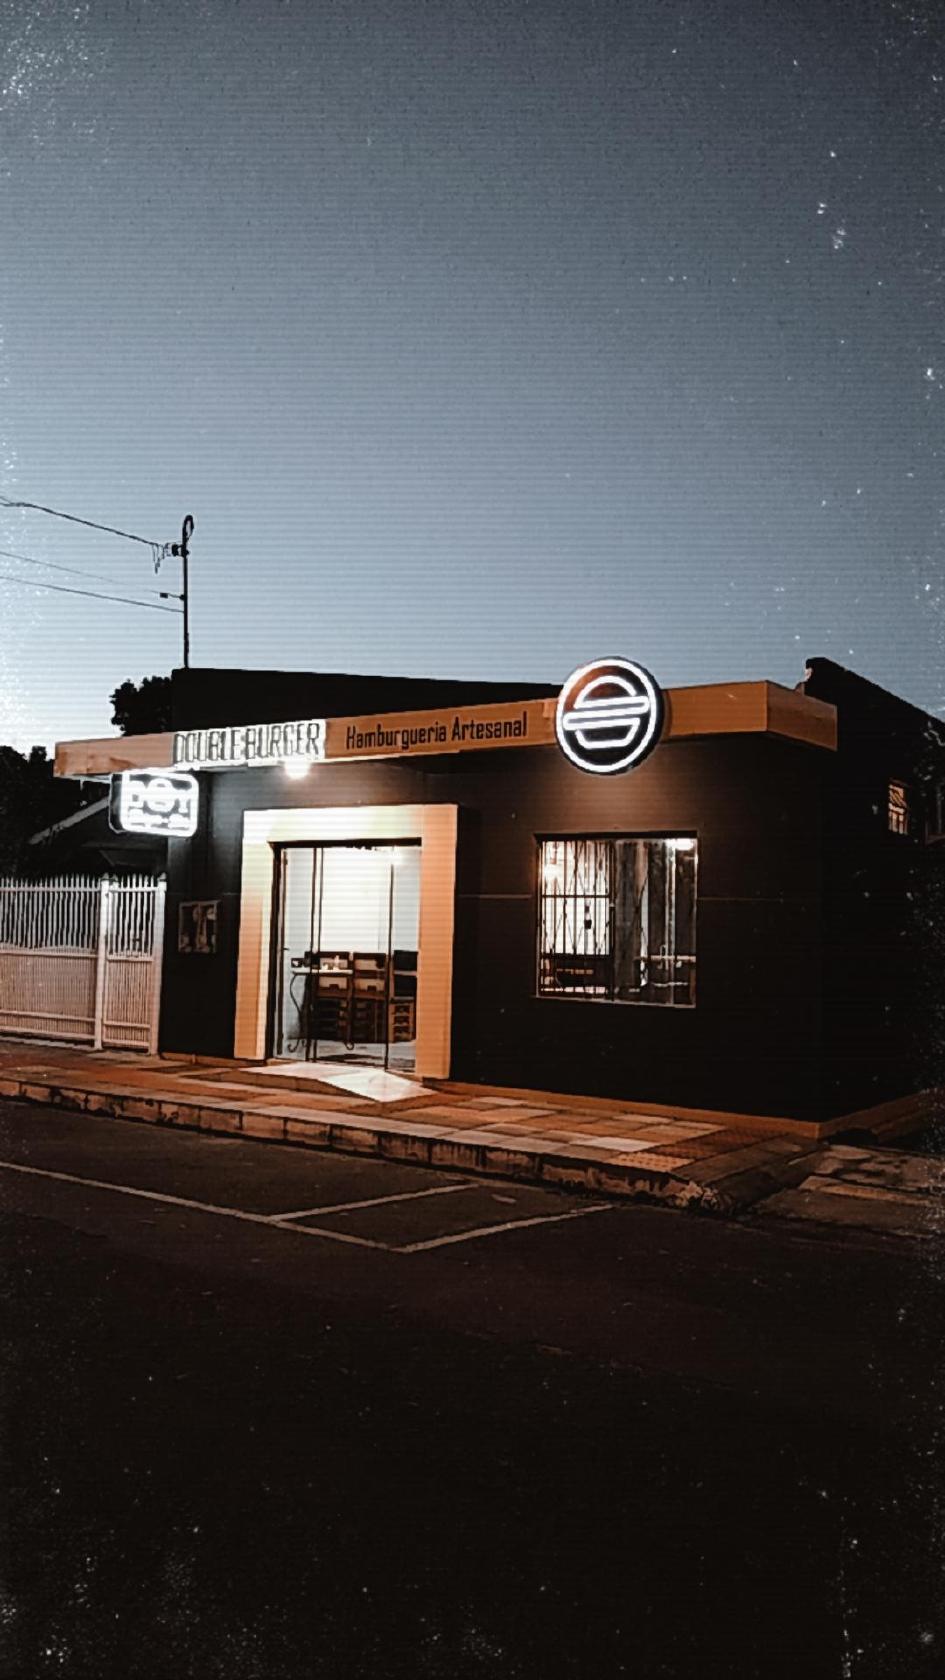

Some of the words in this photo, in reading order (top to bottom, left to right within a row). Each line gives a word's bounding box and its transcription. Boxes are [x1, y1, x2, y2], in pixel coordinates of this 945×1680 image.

[174, 730, 241, 763] DOUBLE
[245, 723, 320, 759] BURGER
[346, 720, 447, 750] Hamburgueria
[451, 711, 528, 741] Artesanal
